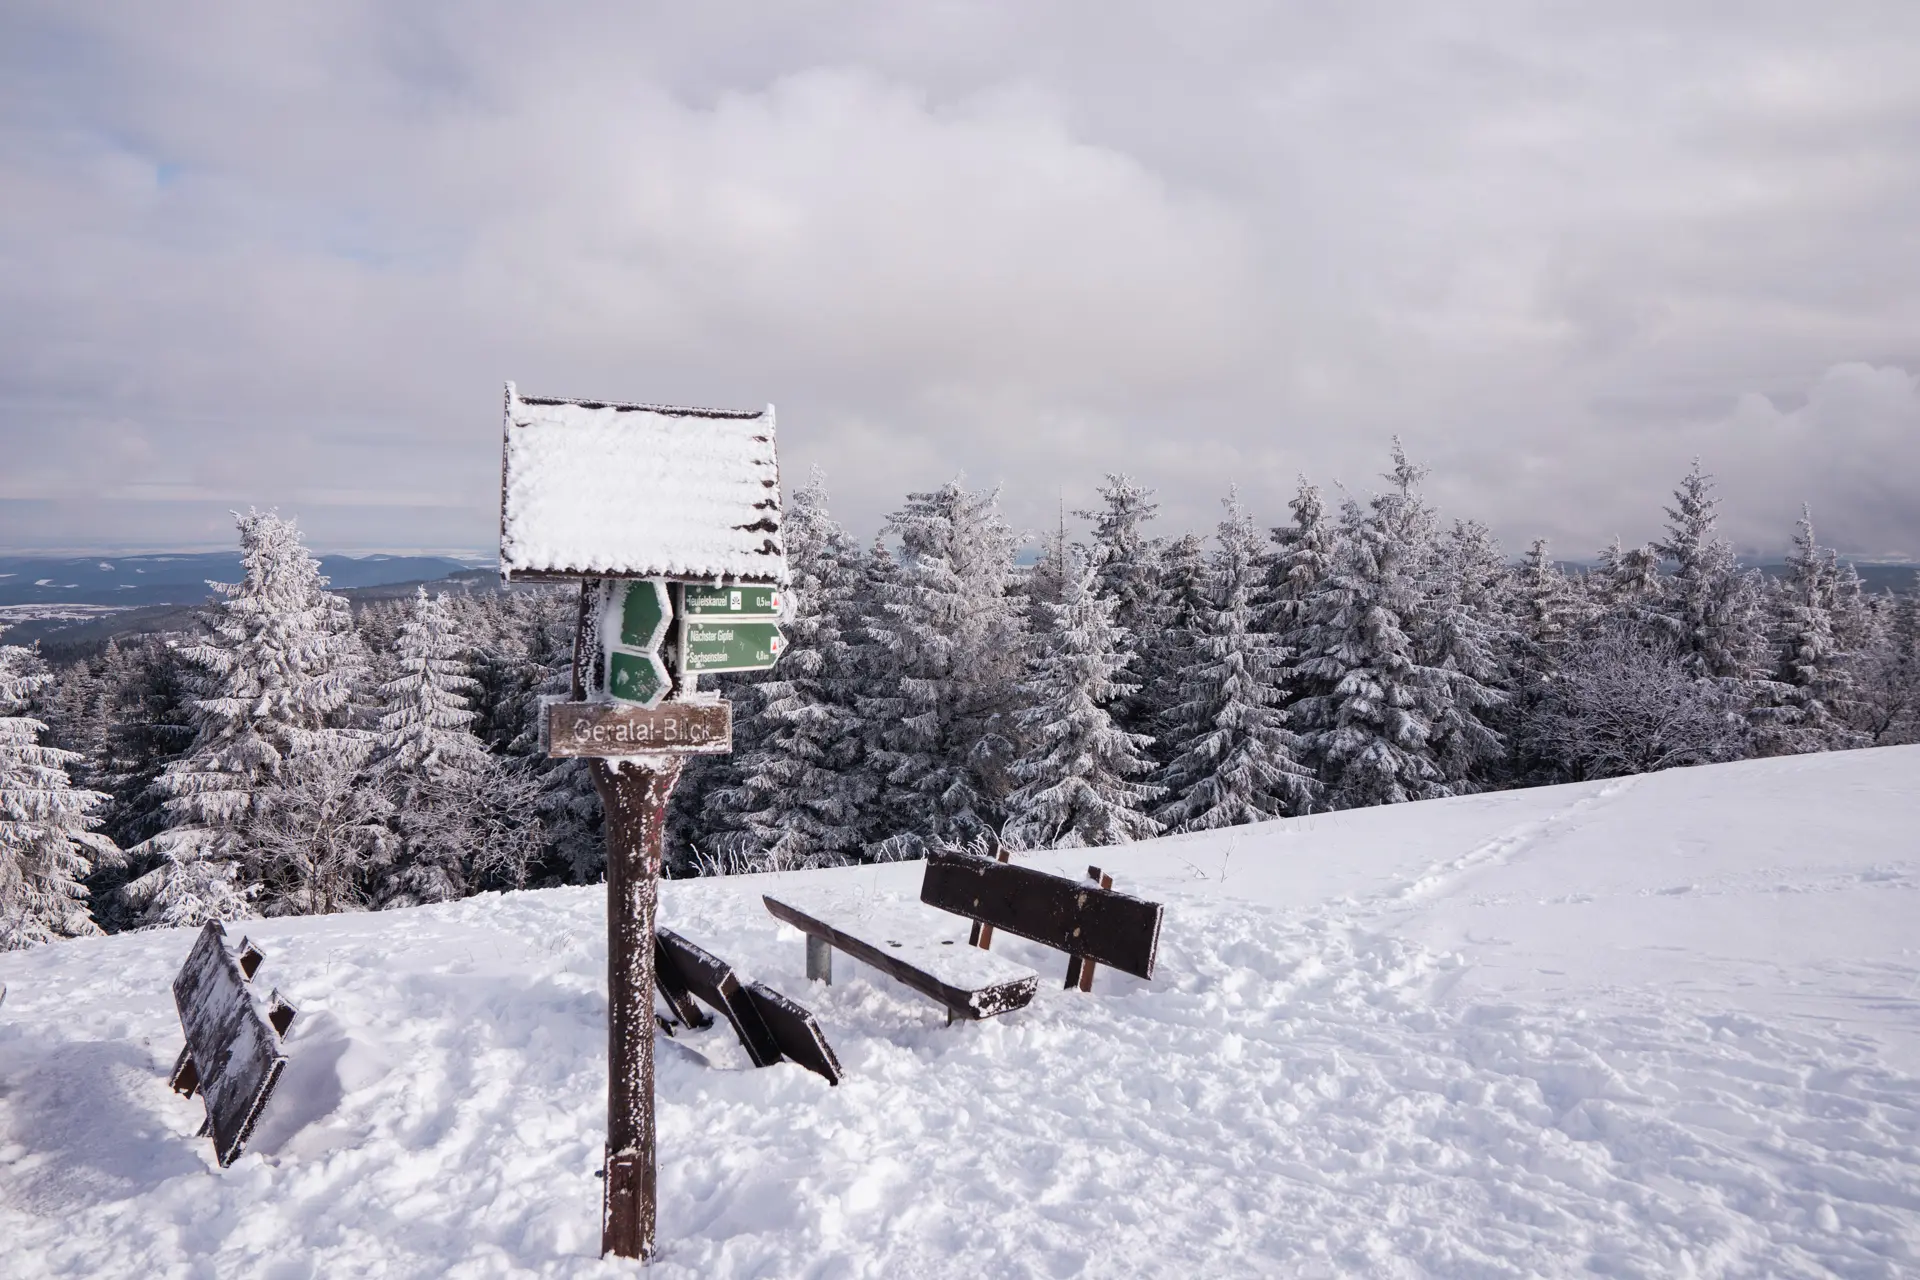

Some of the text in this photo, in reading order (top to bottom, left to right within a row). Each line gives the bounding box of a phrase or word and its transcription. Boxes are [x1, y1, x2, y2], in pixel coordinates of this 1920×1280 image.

[688, 595, 727, 607] Teufelskanzel
[756, 596, 765, 607] 0,5
[690, 630, 734, 643] Nächster Gipfel
[689, 651, 728, 663] Sachsenstein
[572, 717, 711, 743] Geratal-Blick
